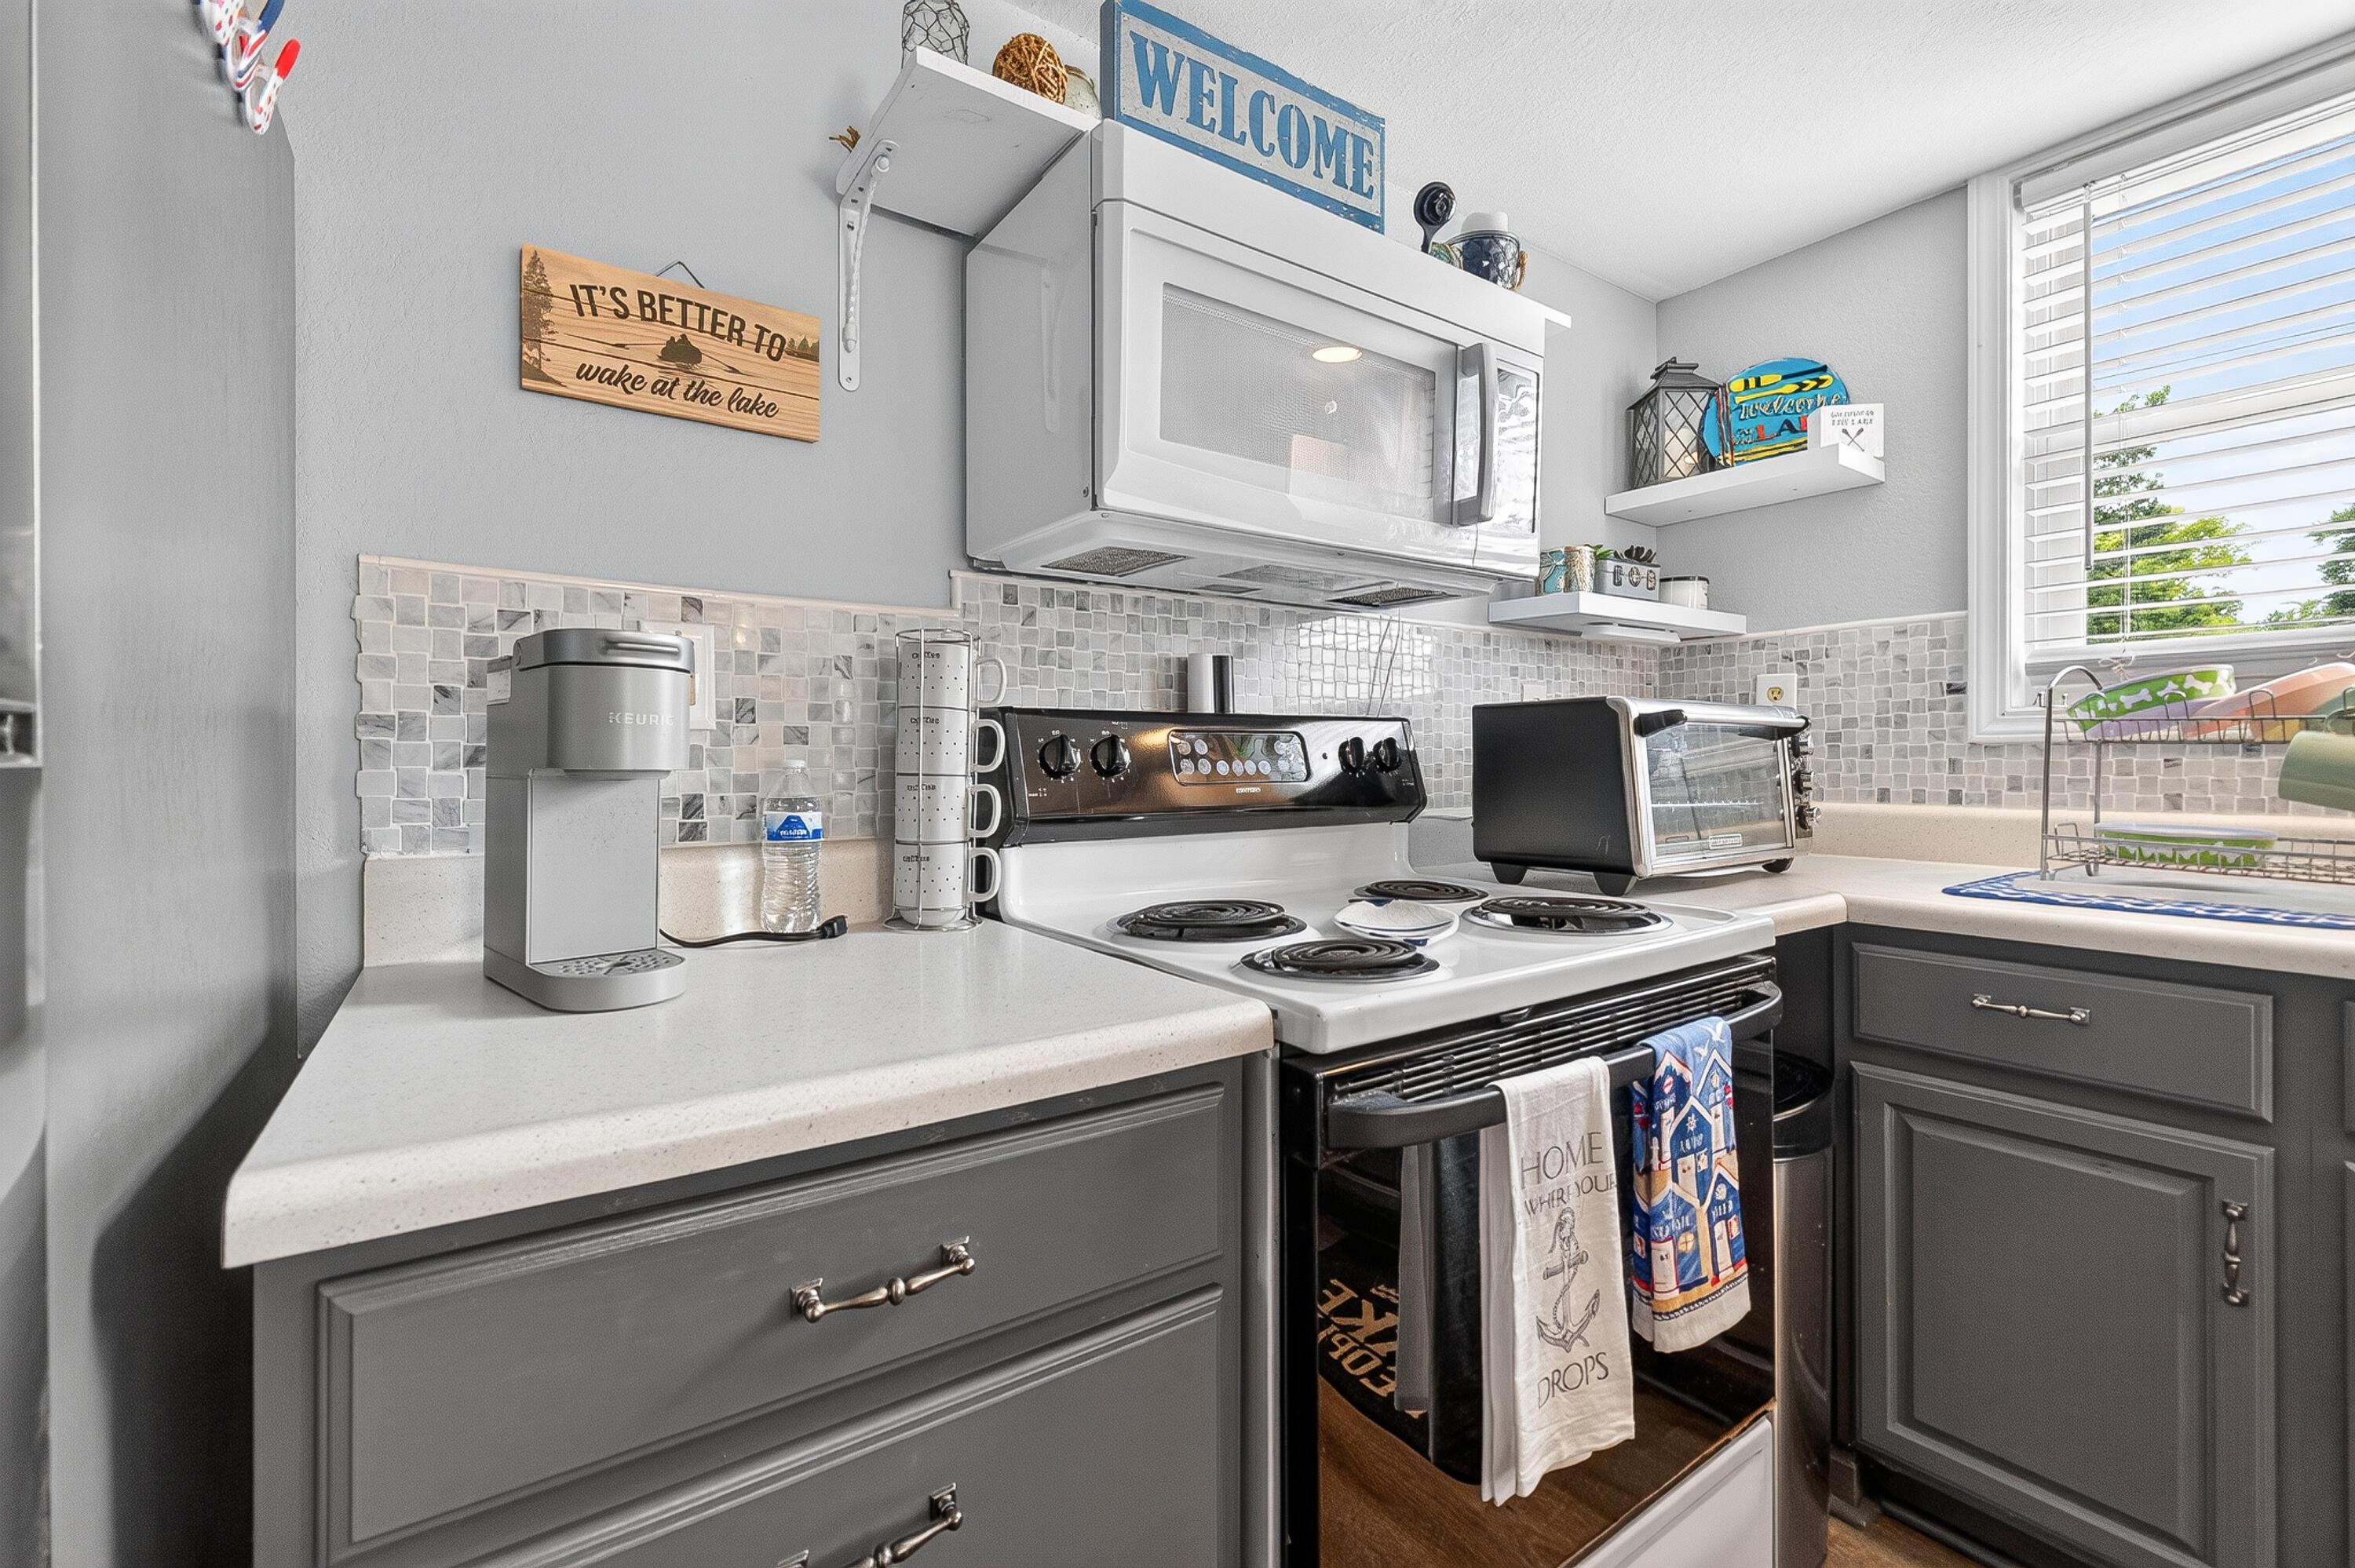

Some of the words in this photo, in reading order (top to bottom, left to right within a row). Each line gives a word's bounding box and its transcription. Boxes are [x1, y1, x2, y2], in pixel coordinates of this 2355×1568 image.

[1129, 30, 1375, 200] WELCOME
[568, 283, 630, 320] IT'S
[637, 289, 747, 347] BETTER
[754, 323, 787, 362] TO
[575, 360, 648, 395] wake
[650, 376, 679, 401] at
[683, 377, 725, 407] the
[728, 386, 780, 419] lake
[1521, 1132, 1604, 1189] HOME
[1537, 1351, 1609, 1409] DROPS
